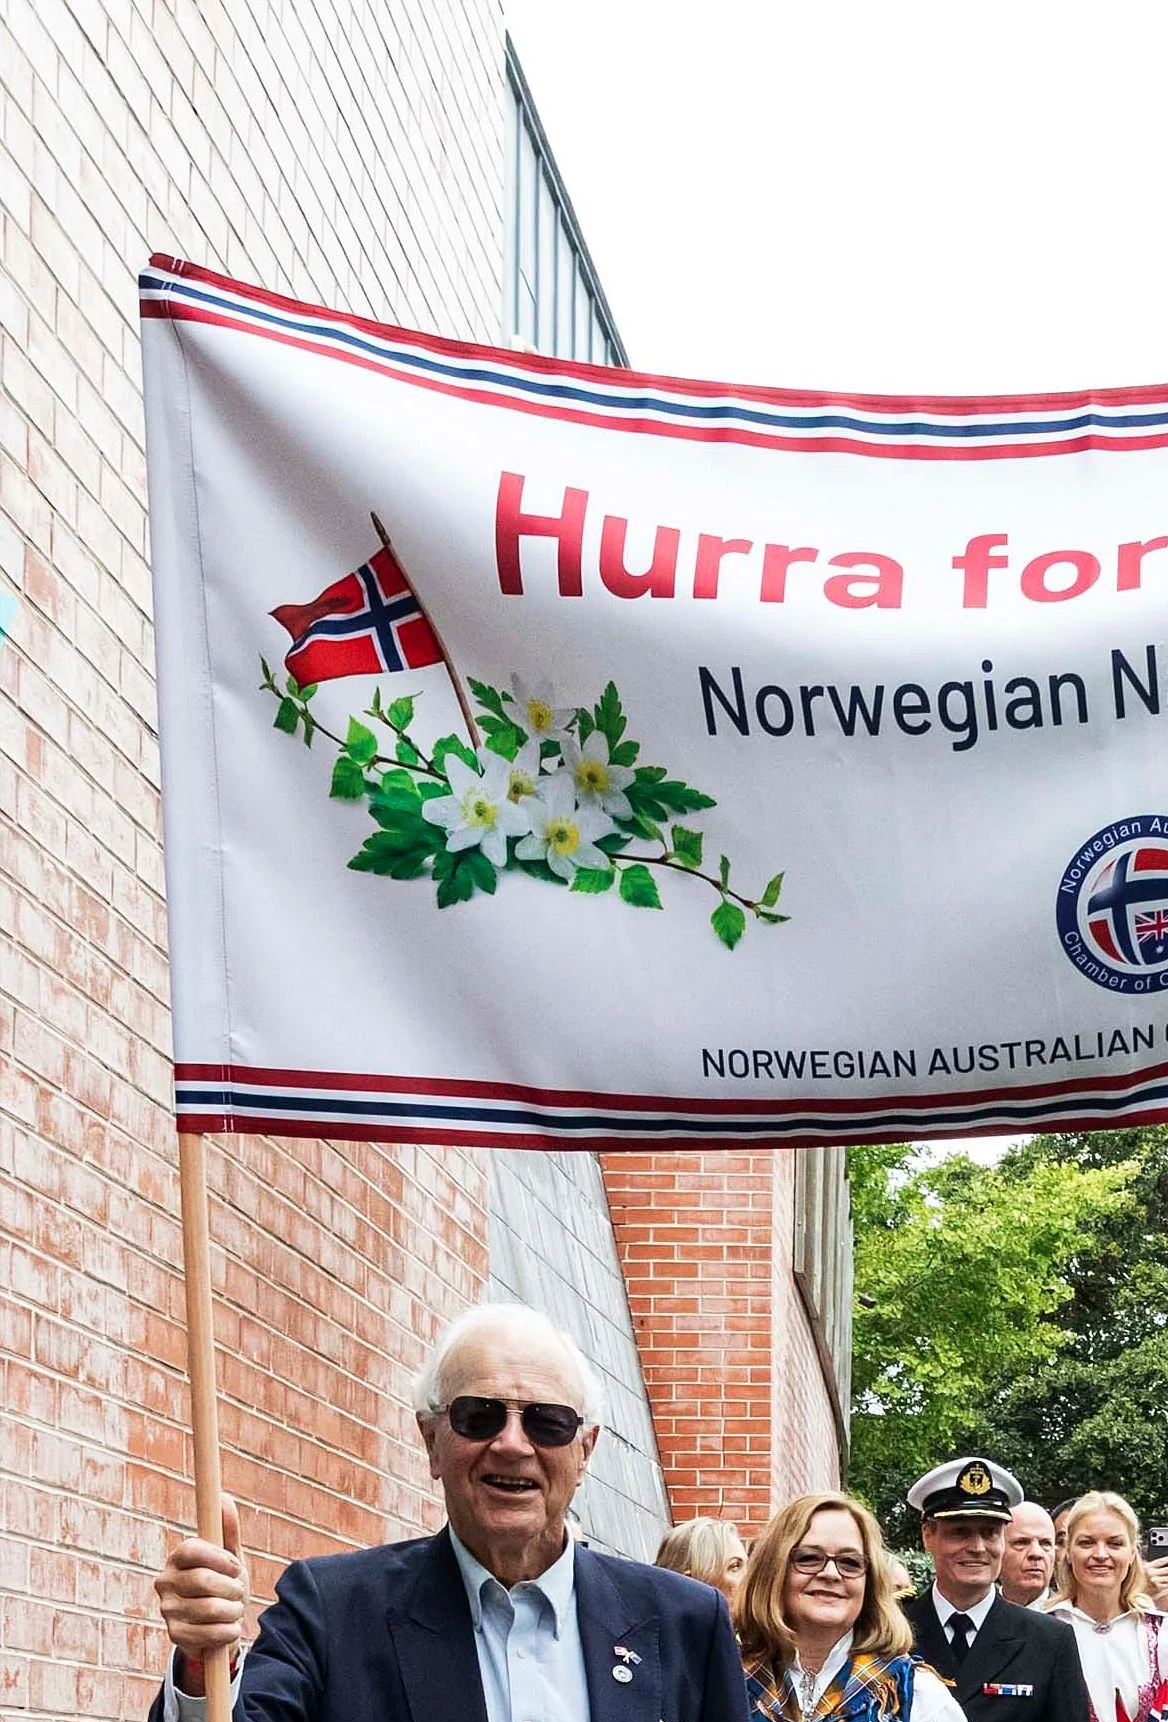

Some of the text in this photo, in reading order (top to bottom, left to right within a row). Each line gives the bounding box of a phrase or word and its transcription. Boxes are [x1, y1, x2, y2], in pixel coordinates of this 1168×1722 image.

[495, 470, 904, 610] Hurra
[698, 657, 1090, 752] Norwegian
[1061, 821, 1142, 894] Norwegian
[1064, 930, 1128, 990] Chamber
[1134, 978, 1151, 991] of
[702, 1048, 918, 1079] NORWEGIAN
[928, 1024, 1156, 1076] AUSTRALIAN
